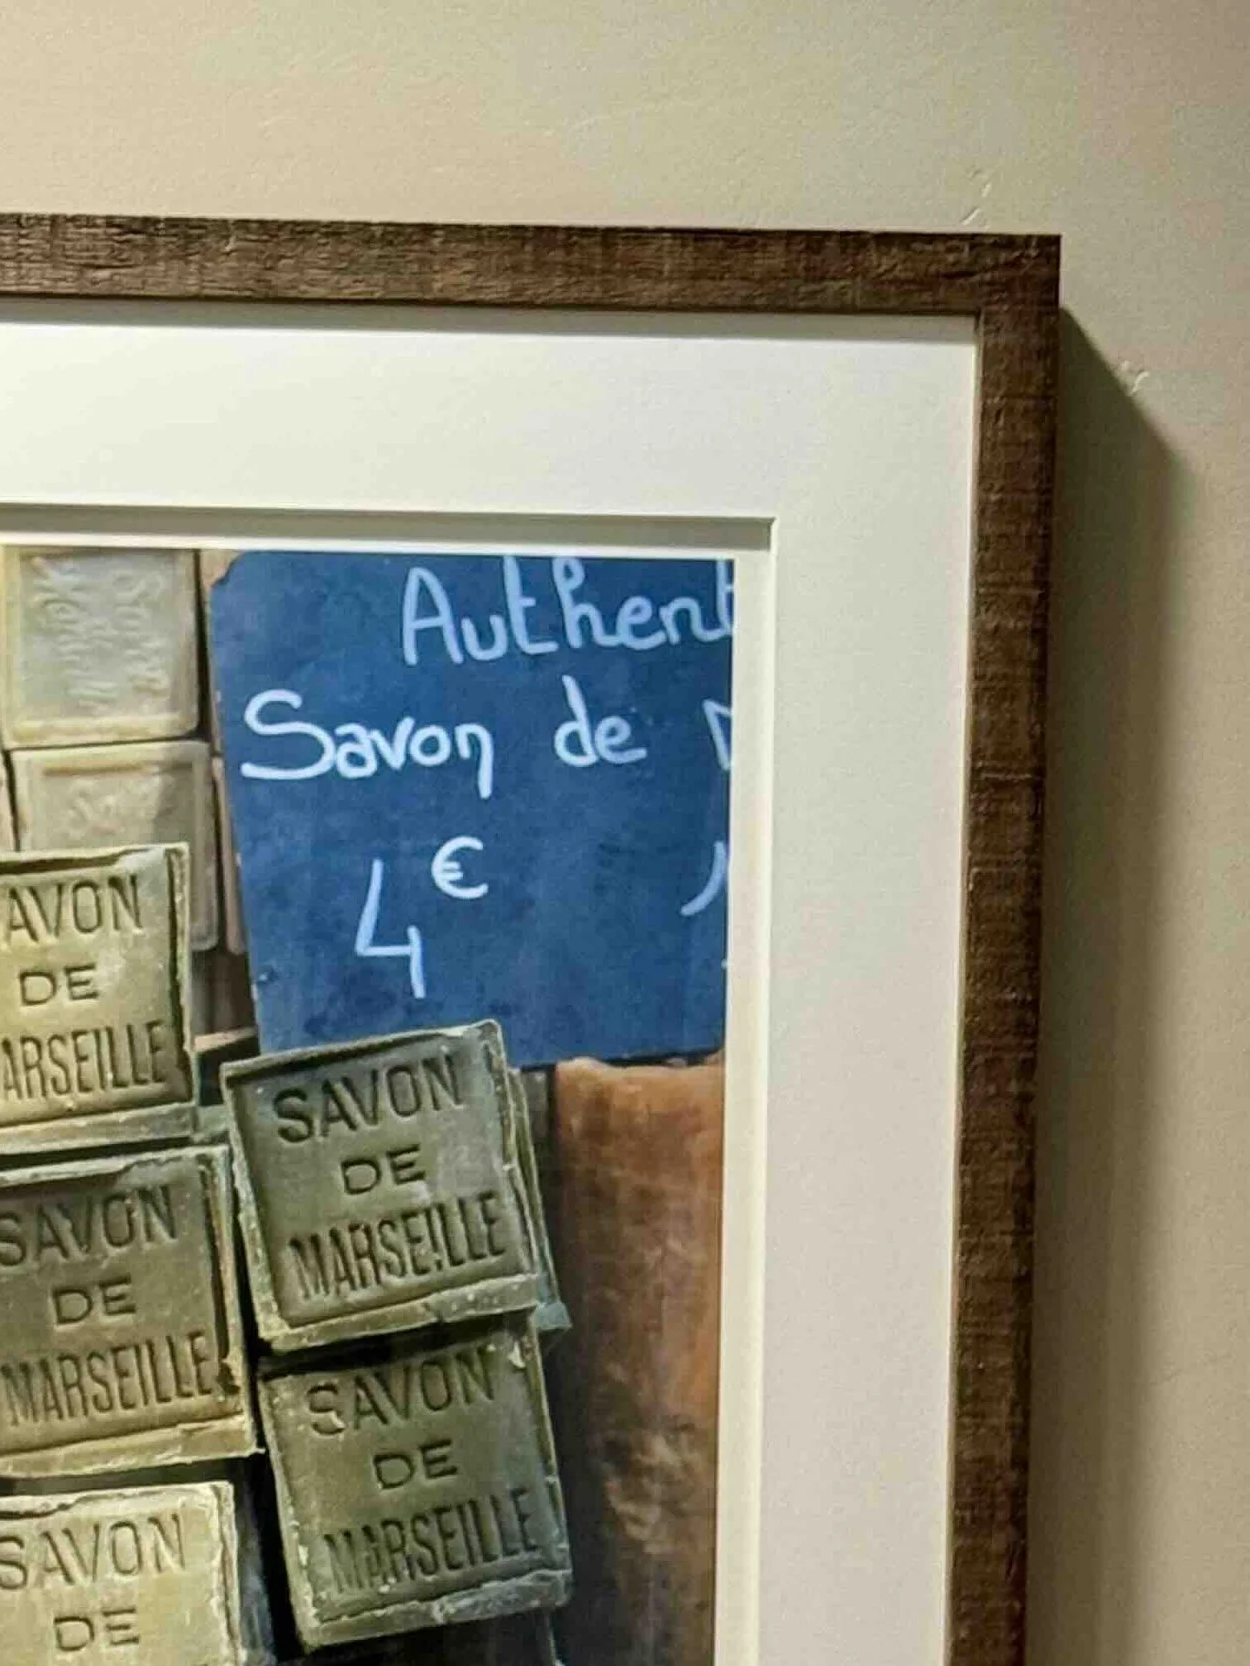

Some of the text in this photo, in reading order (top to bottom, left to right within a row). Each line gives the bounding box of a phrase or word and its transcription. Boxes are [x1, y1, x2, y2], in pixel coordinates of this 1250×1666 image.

[240, 689, 494, 799] Savon
[553, 675, 647, 768] de
[19, 963, 99, 1007] DE
[272, 1053, 463, 1143] SAVON
[341, 1143, 427, 1195] DE
[288, 1190, 506, 1300] MARSEILLE
[52, 1272, 137, 1326] DE
[0, 1329, 213, 1428] MARSEILLE
[306, 1349, 496, 1436] SAVON
[373, 1439, 458, 1490] DE
[323, 1487, 538, 1594] MARSEILLE
[54, 1605, 141, 1652] DE
